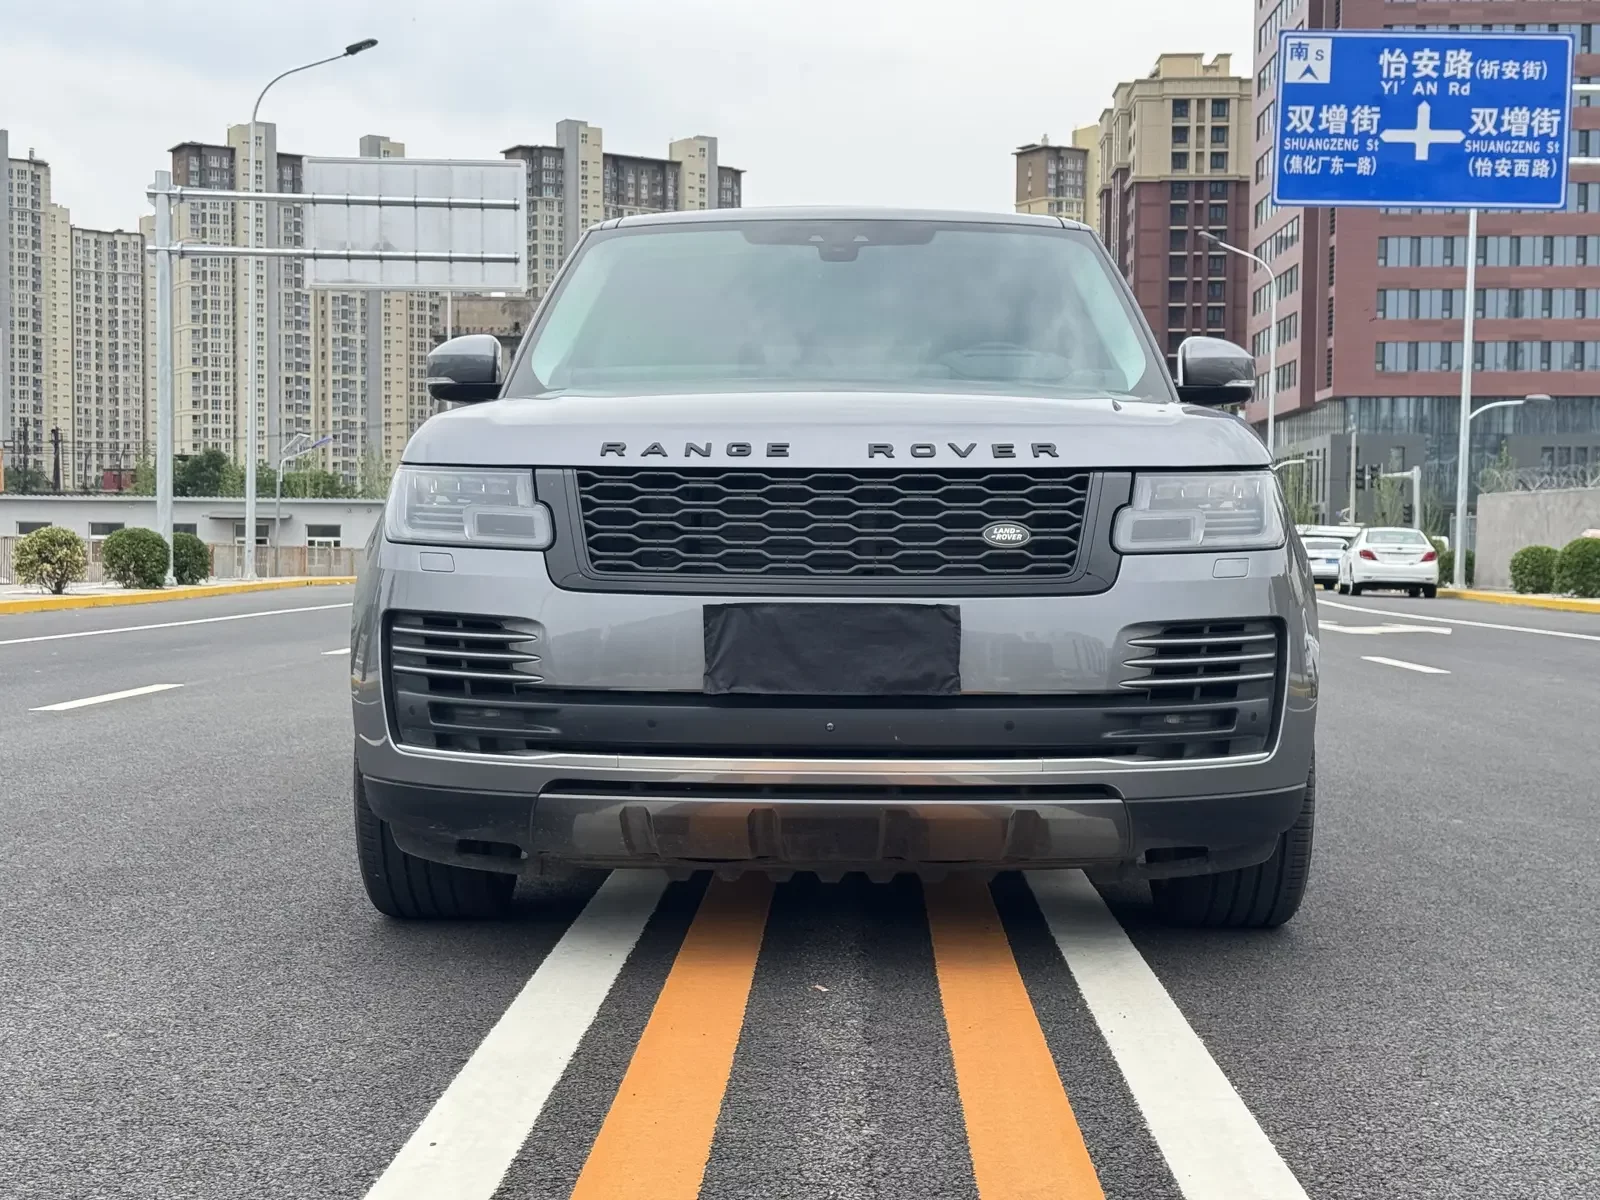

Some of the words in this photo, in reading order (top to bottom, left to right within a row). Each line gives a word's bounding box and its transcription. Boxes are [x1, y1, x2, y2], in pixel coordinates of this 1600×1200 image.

[1289, 42, 1310, 61] 南
[1315, 49, 1325, 61] S
[1379, 48, 1474, 79] 怡安路
[1448, 82, 1471, 96] Rd
[1285, 104, 1381, 135] 双增街
[1468, 106, 1561, 138] 双增街
[1283, 138, 1359, 151] SHUANGZENG
[1366, 139, 1379, 152] St
[1464, 140, 1541, 154] SHUANGZENG
[1546, 141, 1560, 154] St
[1283, 154, 1377, 176] (焦化厂东一路)
[1468, 156, 1557, 178] (怡安西路)
[600, 441, 791, 458] RANGE
[867, 442, 1063, 459] ROVER
